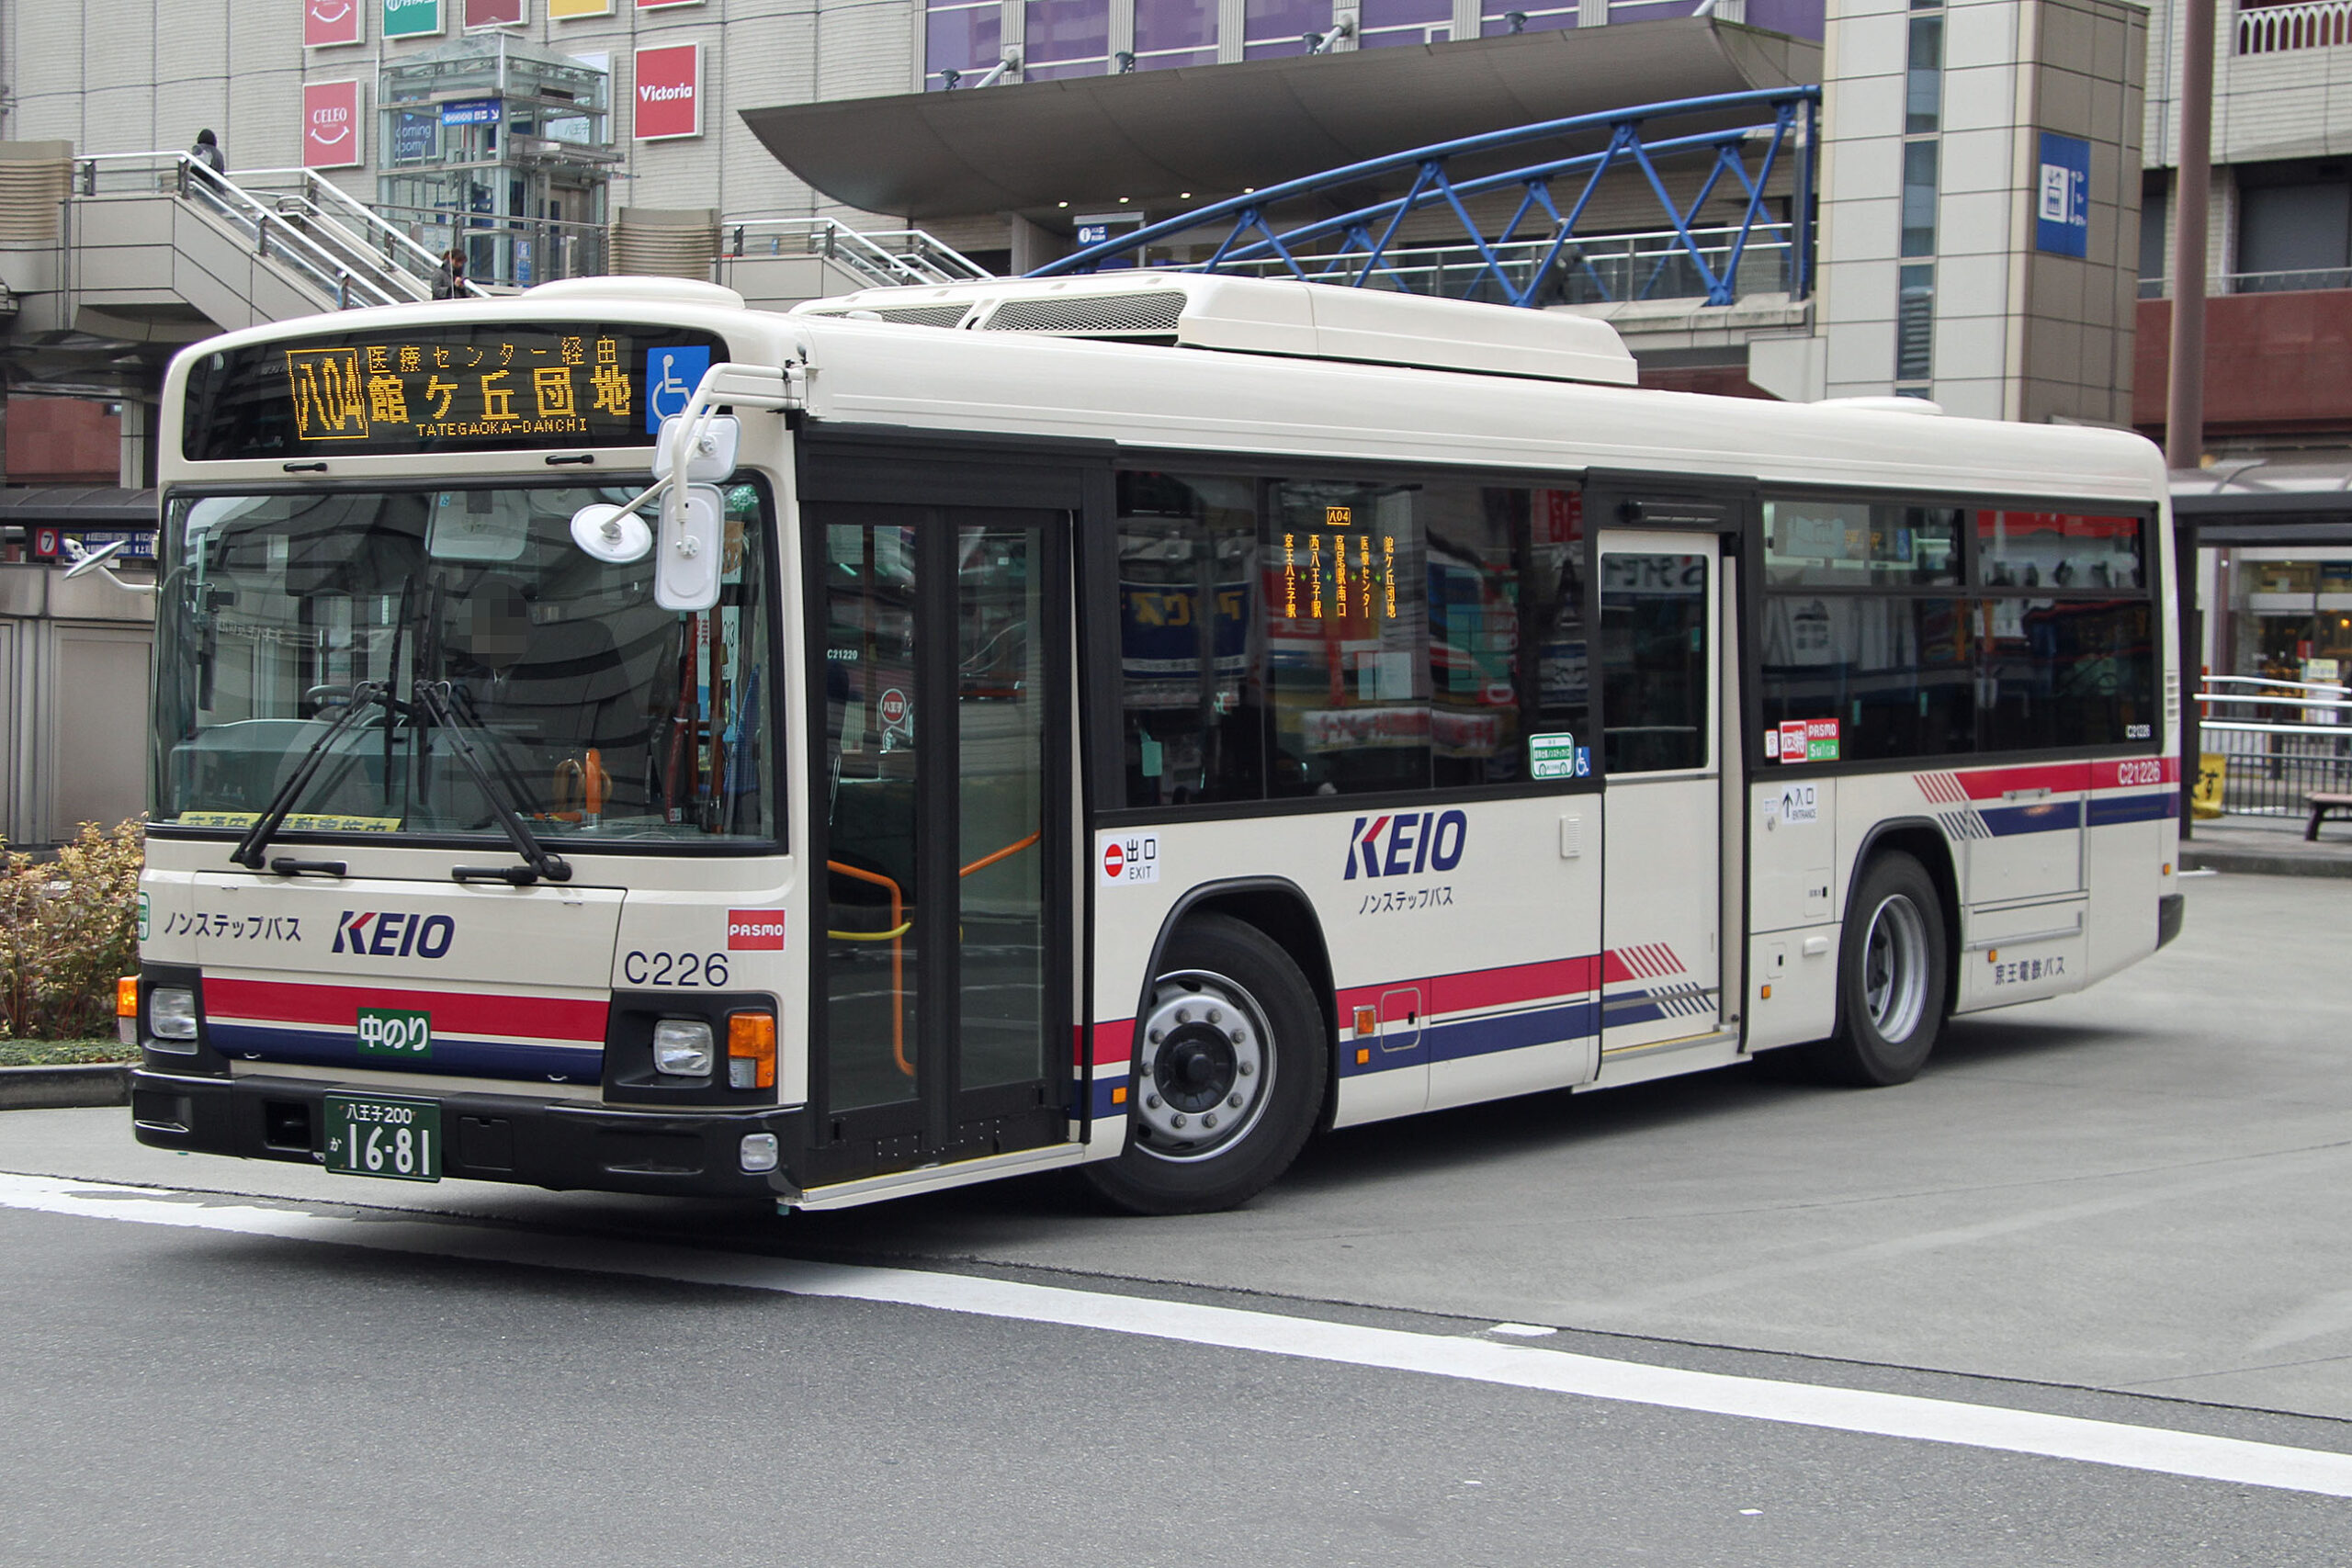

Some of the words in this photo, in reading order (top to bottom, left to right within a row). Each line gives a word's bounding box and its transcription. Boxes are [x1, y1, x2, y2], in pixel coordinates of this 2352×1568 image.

[639, 83, 693, 102] Victoria
[313, 107, 348, 125] CELEO
[367, 335, 617, 374] 医療センター経由
[415, 417, 587, 437] TATEGAOKA-DANCHI
[1329, 509, 1350, 523] 八04
[43, 535, 53, 550] 7
[1283, 533, 1296, 618] 京王八王子駅
[1309, 535, 1322, 618] 西八王子駅
[1334, 535, 1347, 618] 高尾駅南口
[1808, 724, 1837, 738] PASMO
[2118, 761, 2161, 786] C21226
[1795, 787, 1815, 807] 入口
[1126, 839, 1156, 863] 出口
[1343, 809, 1467, 880] KEIO
[1129, 865, 1152, 880] EXIT
[1359, 886, 1453, 915] ノンステップバス
[164, 911, 302, 942] ノンステップバス
[332, 910, 456, 959] KEIO
[729, 923, 784, 937] PASMO
[625, 950, 729, 987] C226
[1995, 956, 2065, 987] 京王電鉄バス
[359, 1013, 429, 1052] 中のり
[329, 1137, 343, 1152] か
[349, 1123, 430, 1176] 16-81
